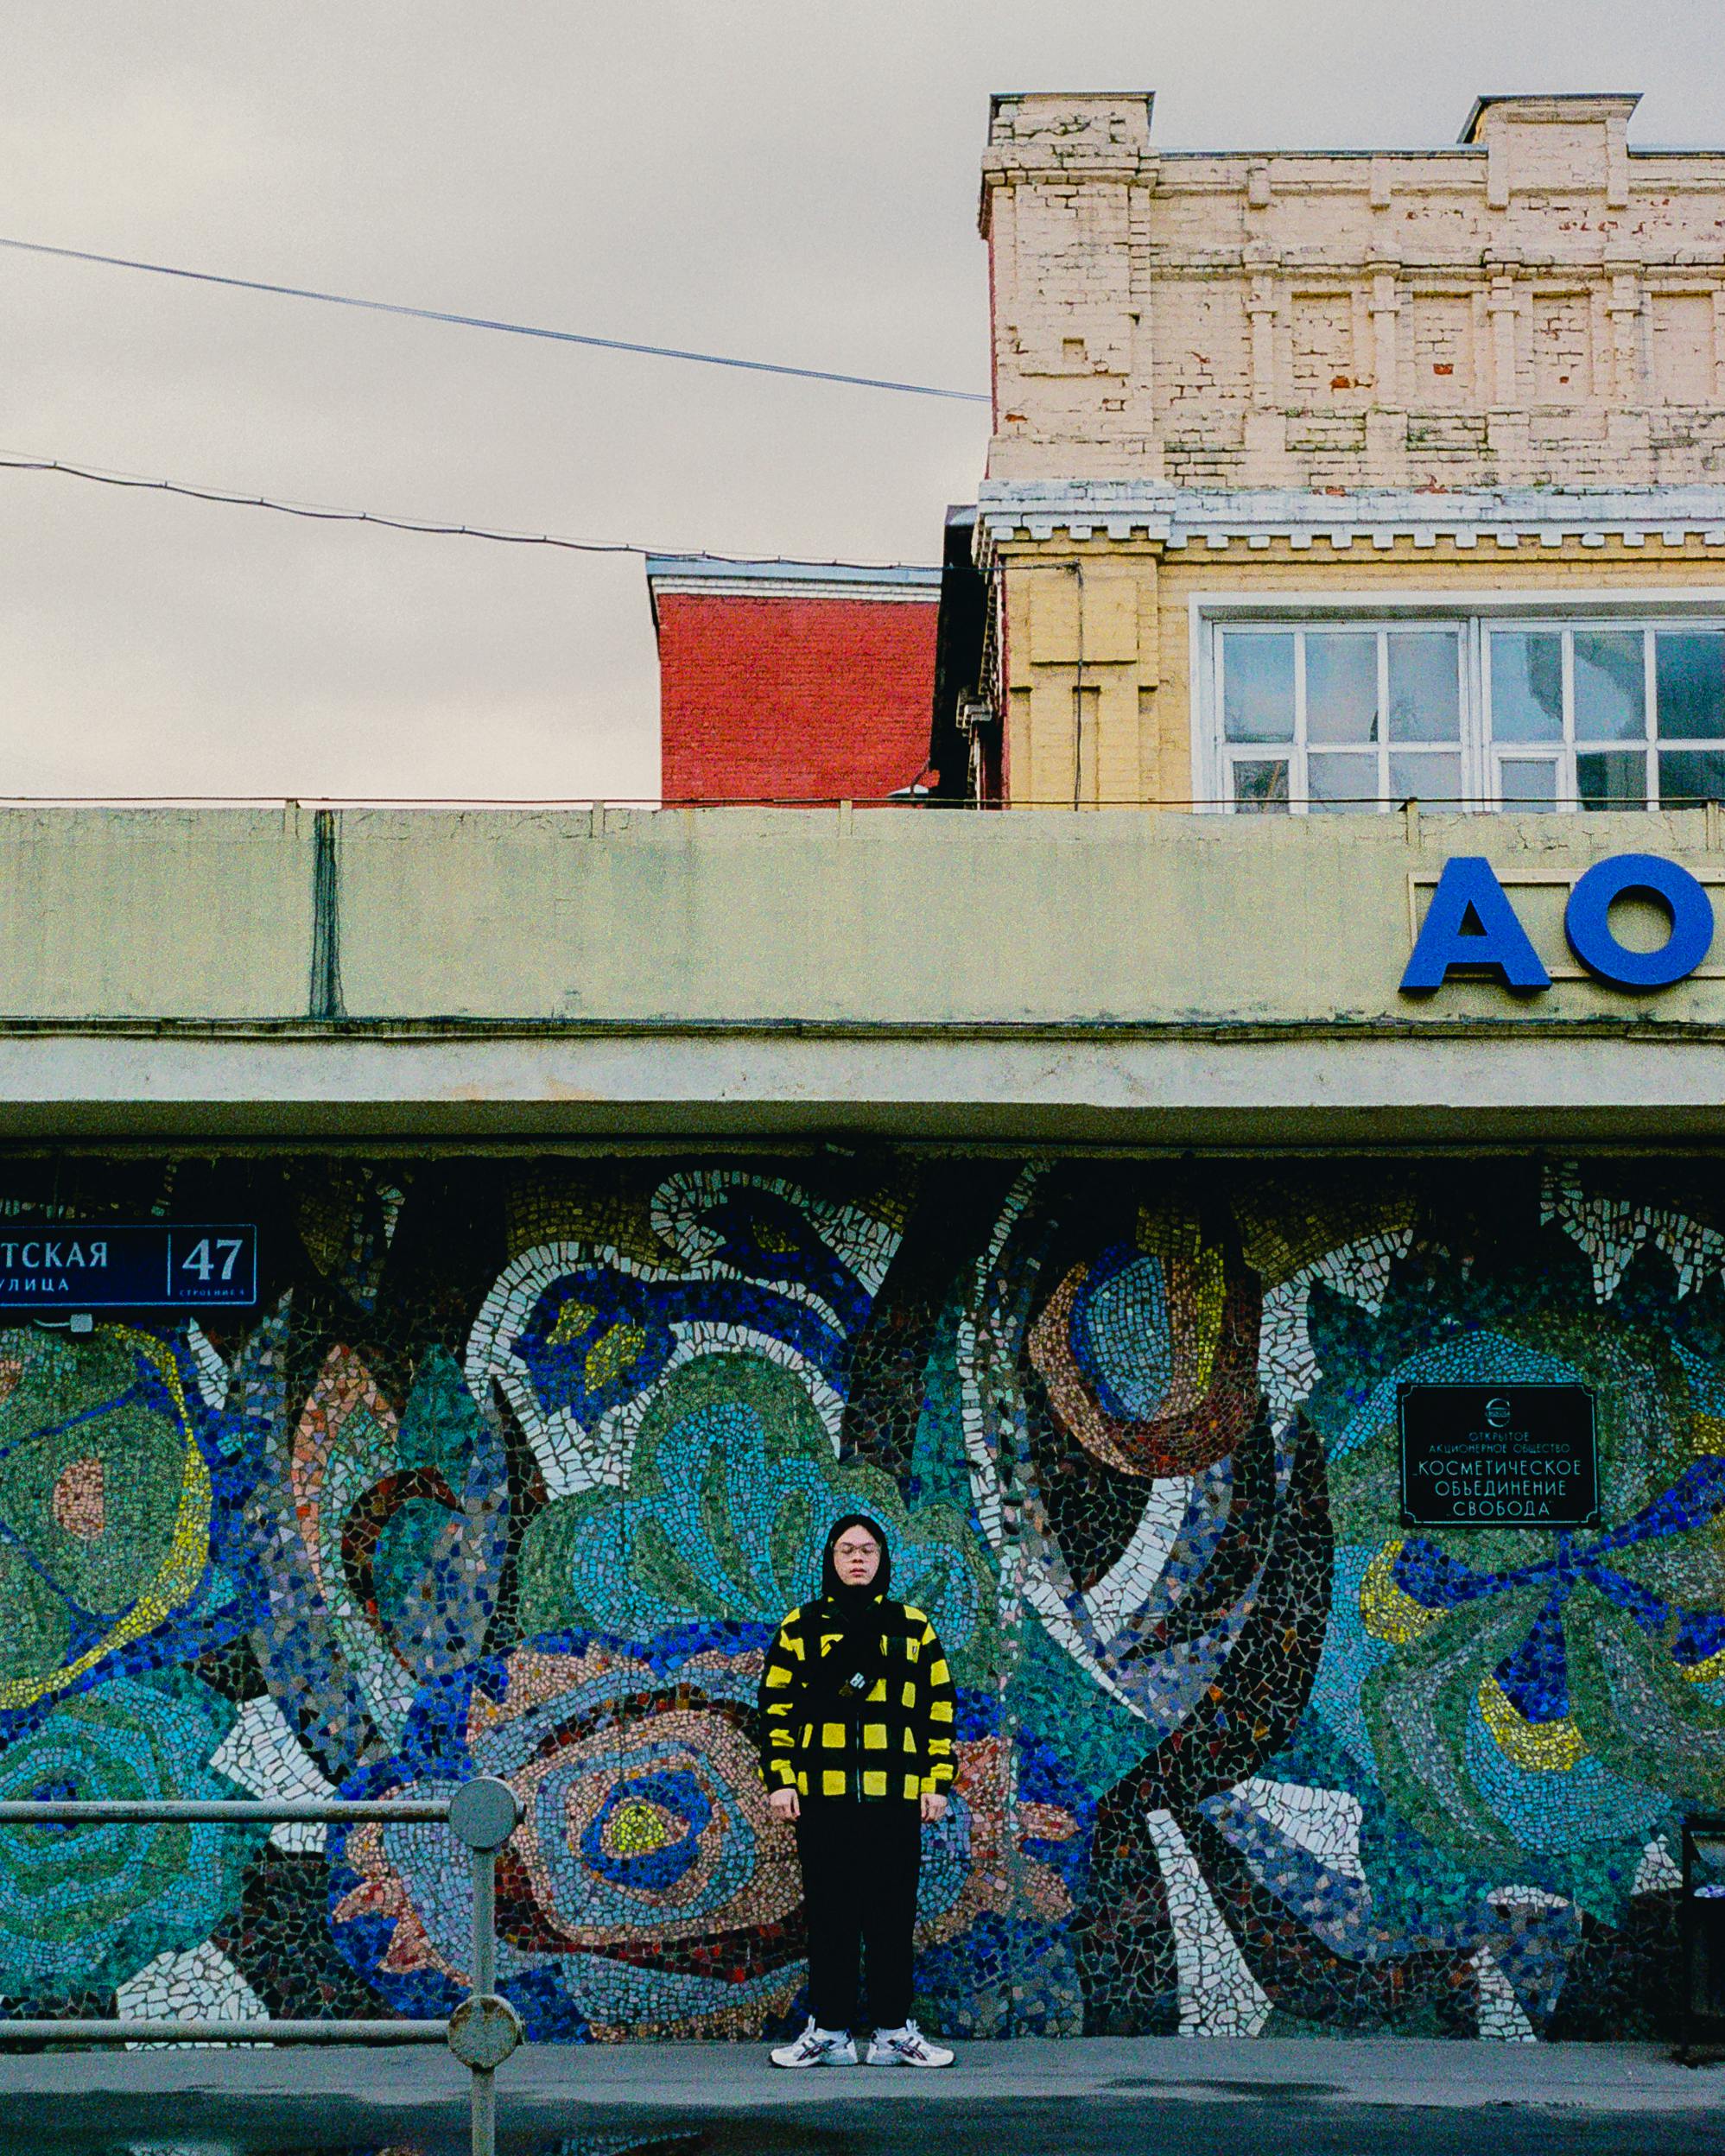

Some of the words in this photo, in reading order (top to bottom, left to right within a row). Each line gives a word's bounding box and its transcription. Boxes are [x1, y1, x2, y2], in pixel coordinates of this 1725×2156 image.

[1398, 853, 1715, 992] АО
[0, 1241, 108, 1268] ТСКАЯ
[181, 1239, 244, 1280] 47
[1468, 1431, 1530, 1442] ОТКРЫТОЕ
[1429, 1443, 1507, 1455] АКЦИОНЕРНОЕ
[1513, 1443, 1570, 1455] ОБЩЕСТВО
[1435, 1481, 1567, 1497] ОБЪЕДИНЕНИЕ
